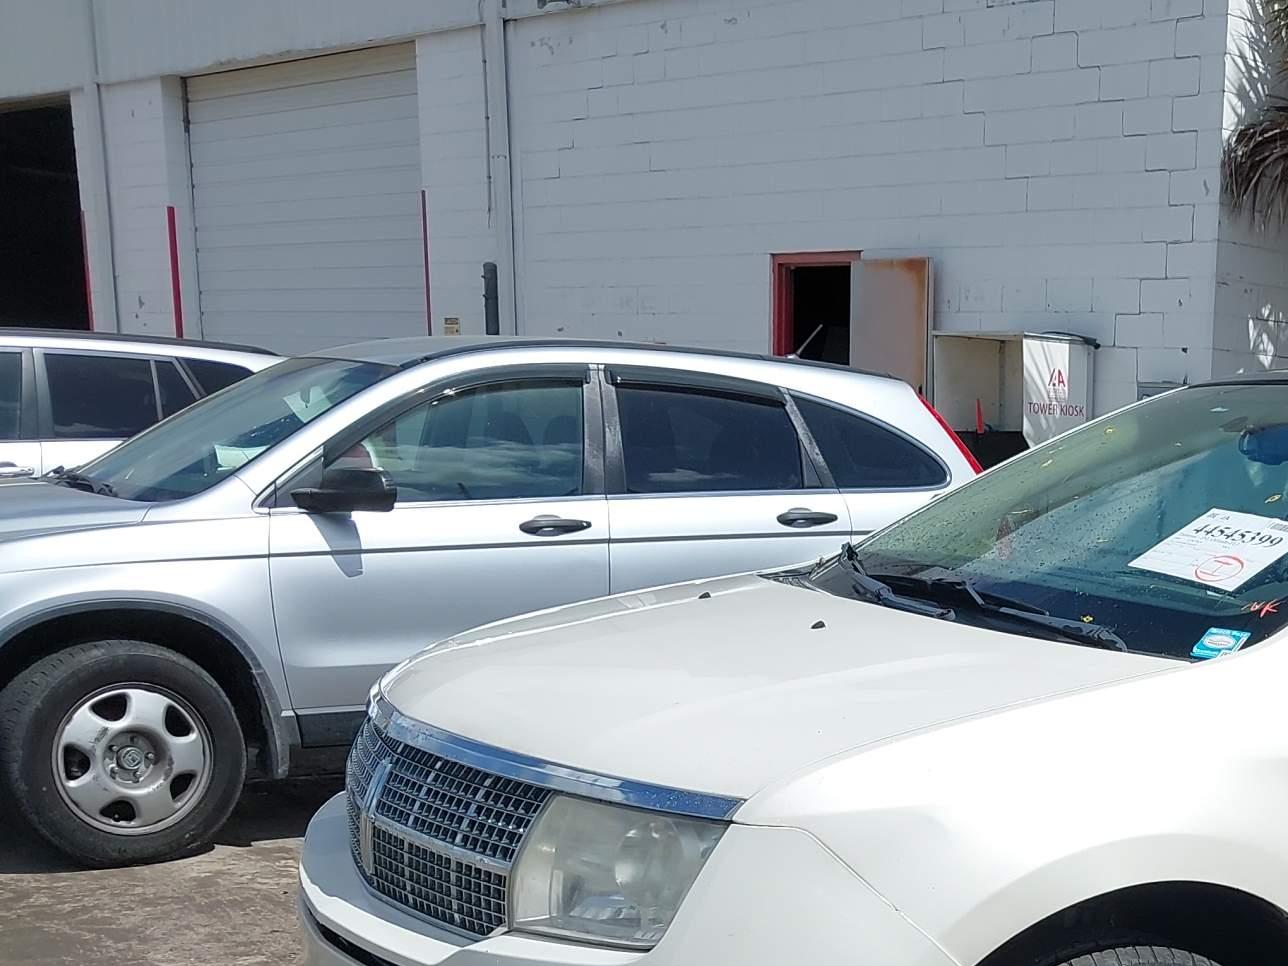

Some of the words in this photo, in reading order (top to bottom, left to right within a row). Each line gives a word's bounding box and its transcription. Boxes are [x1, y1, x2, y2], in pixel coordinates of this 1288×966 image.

[1028, 402, 1058, 416] TOWER
[1060, 405, 1085, 417] KIOSK
[1193, 524, 1284, 548] 44545399
